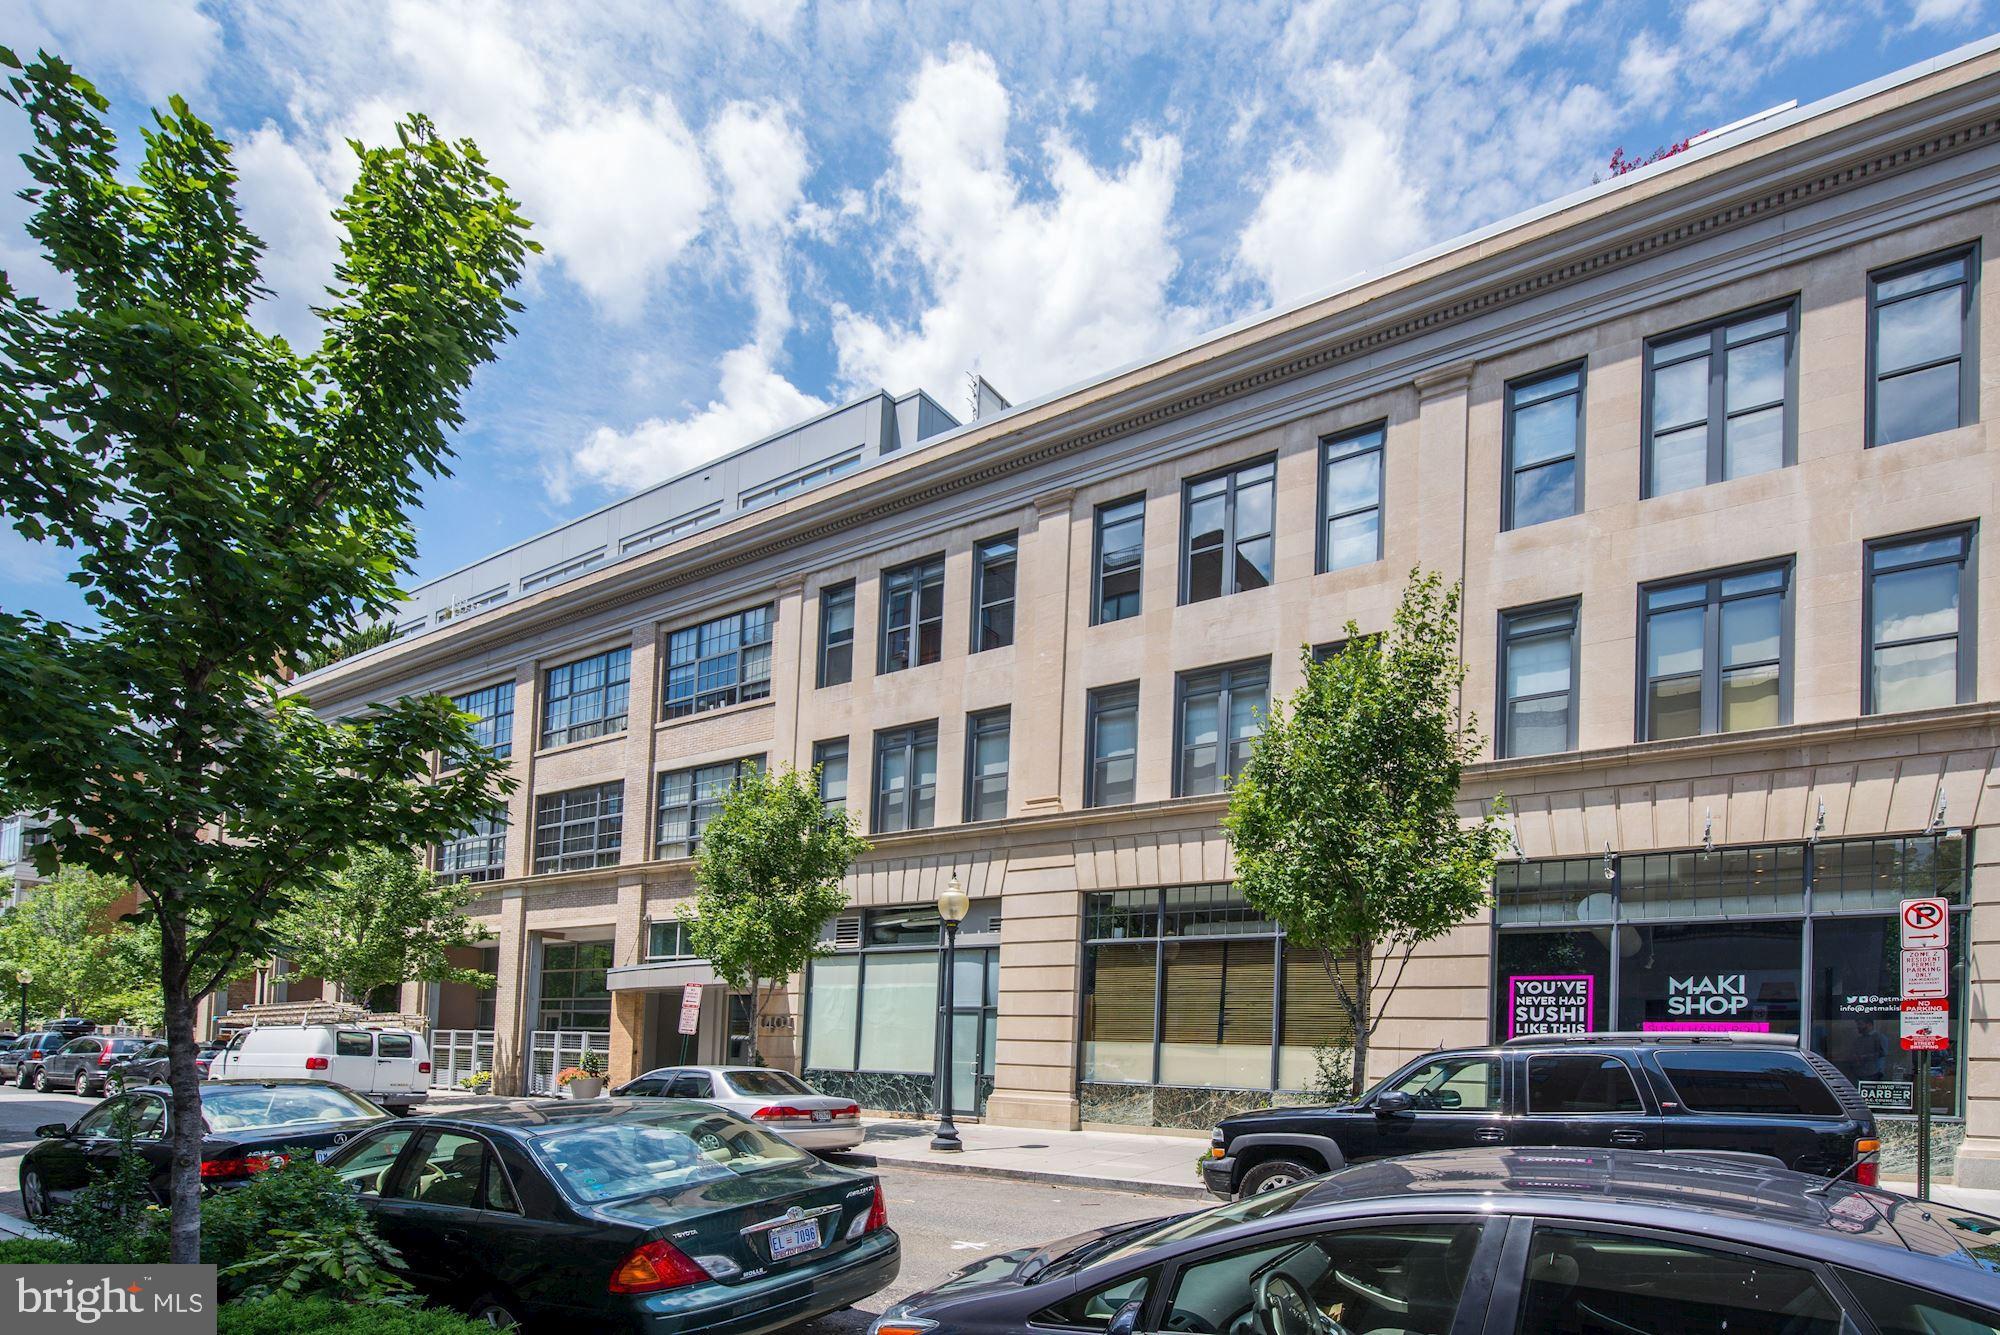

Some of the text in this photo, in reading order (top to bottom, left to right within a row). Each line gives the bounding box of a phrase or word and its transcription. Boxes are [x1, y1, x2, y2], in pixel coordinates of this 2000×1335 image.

[1516, 981, 1587, 995] YOU'VE
[1669, 974, 1745, 995] MAKI
[1516, 996, 1586, 1005] NEVER HAD
[1668, 995, 1748, 1015] SHOP
[1516, 1006, 1585, 1022] SUSHI
[1516, 1023, 1586, 1034] LIKE THIS
[672, 1229, 698, 1239] TOYOTA
[772, 1237, 785, 1251] EL
[794, 1227, 816, 1244] 7096
